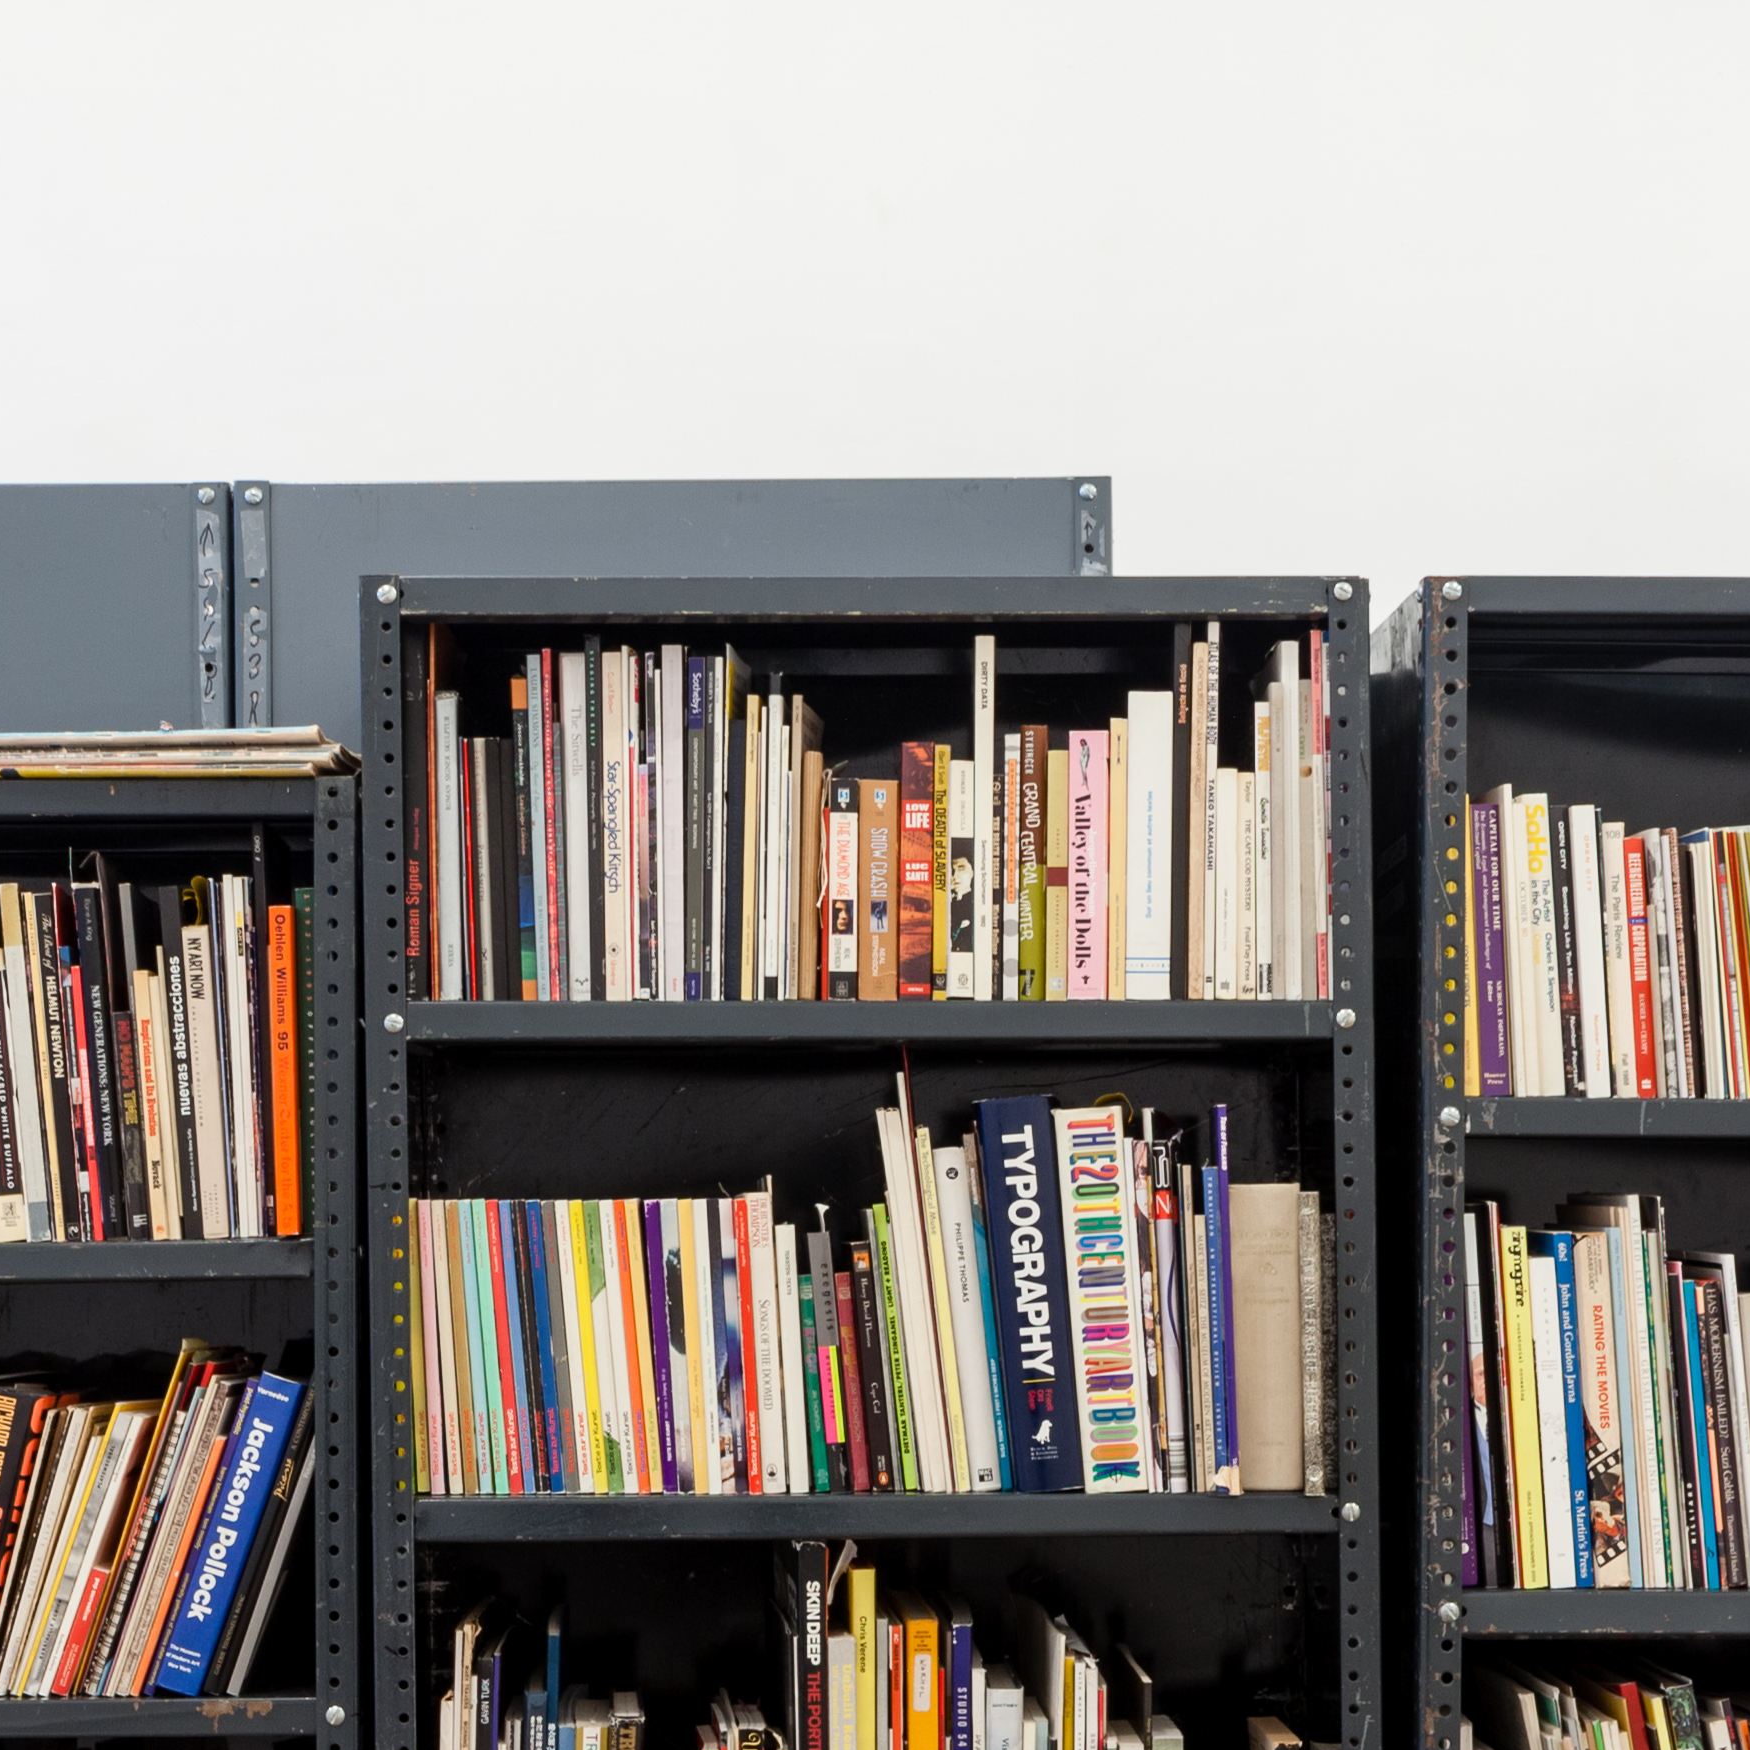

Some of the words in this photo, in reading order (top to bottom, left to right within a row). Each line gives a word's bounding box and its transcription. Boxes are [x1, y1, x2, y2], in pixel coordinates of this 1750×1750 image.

[605, 761, 621, 850] Star-Spangled
[936, 789, 946, 805] The
[1024, 782, 1041, 828] GRAND
[870, 828, 888, 858] SNOW
[936, 808, 946, 837] DEATH
[1072, 793, 1091, 852] Valley
[1525, 804, 1548, 874] SoHo
[936, 841, 946, 849] of
[1020, 831, 1039, 887] CENTRAL
[1075, 856, 1091, 877] of
[605, 854, 621, 893] Kitsch
[871, 862, 888, 898] CRASH
[936, 851, 946, 892] SLAVERY
[1020, 890, 1034, 941] WINTER
[1075, 880, 1091, 915] the
[275, 914, 287, 961] Oehlen
[1075, 918, 1092, 968] Dolls
[276, 967, 288, 1025] Williams
[277, 1031, 289, 1051] 95
[954, 1223, 964, 1261] PHILIPPE
[999, 1124, 1054, 1375] TYPOGRAPHY
[958, 1265, 969, 1303] THOMAS
[1592, 1305, 1607, 1351] RATING
[1595, 1355, 1606, 1377] THE
[1595, 1381, 1610, 1429] MOVIES
[224, 1417, 274, 1522] Jackson
[187, 1526, 239, 1622] Pollock
[807, 1672, 821, 1698] THE
